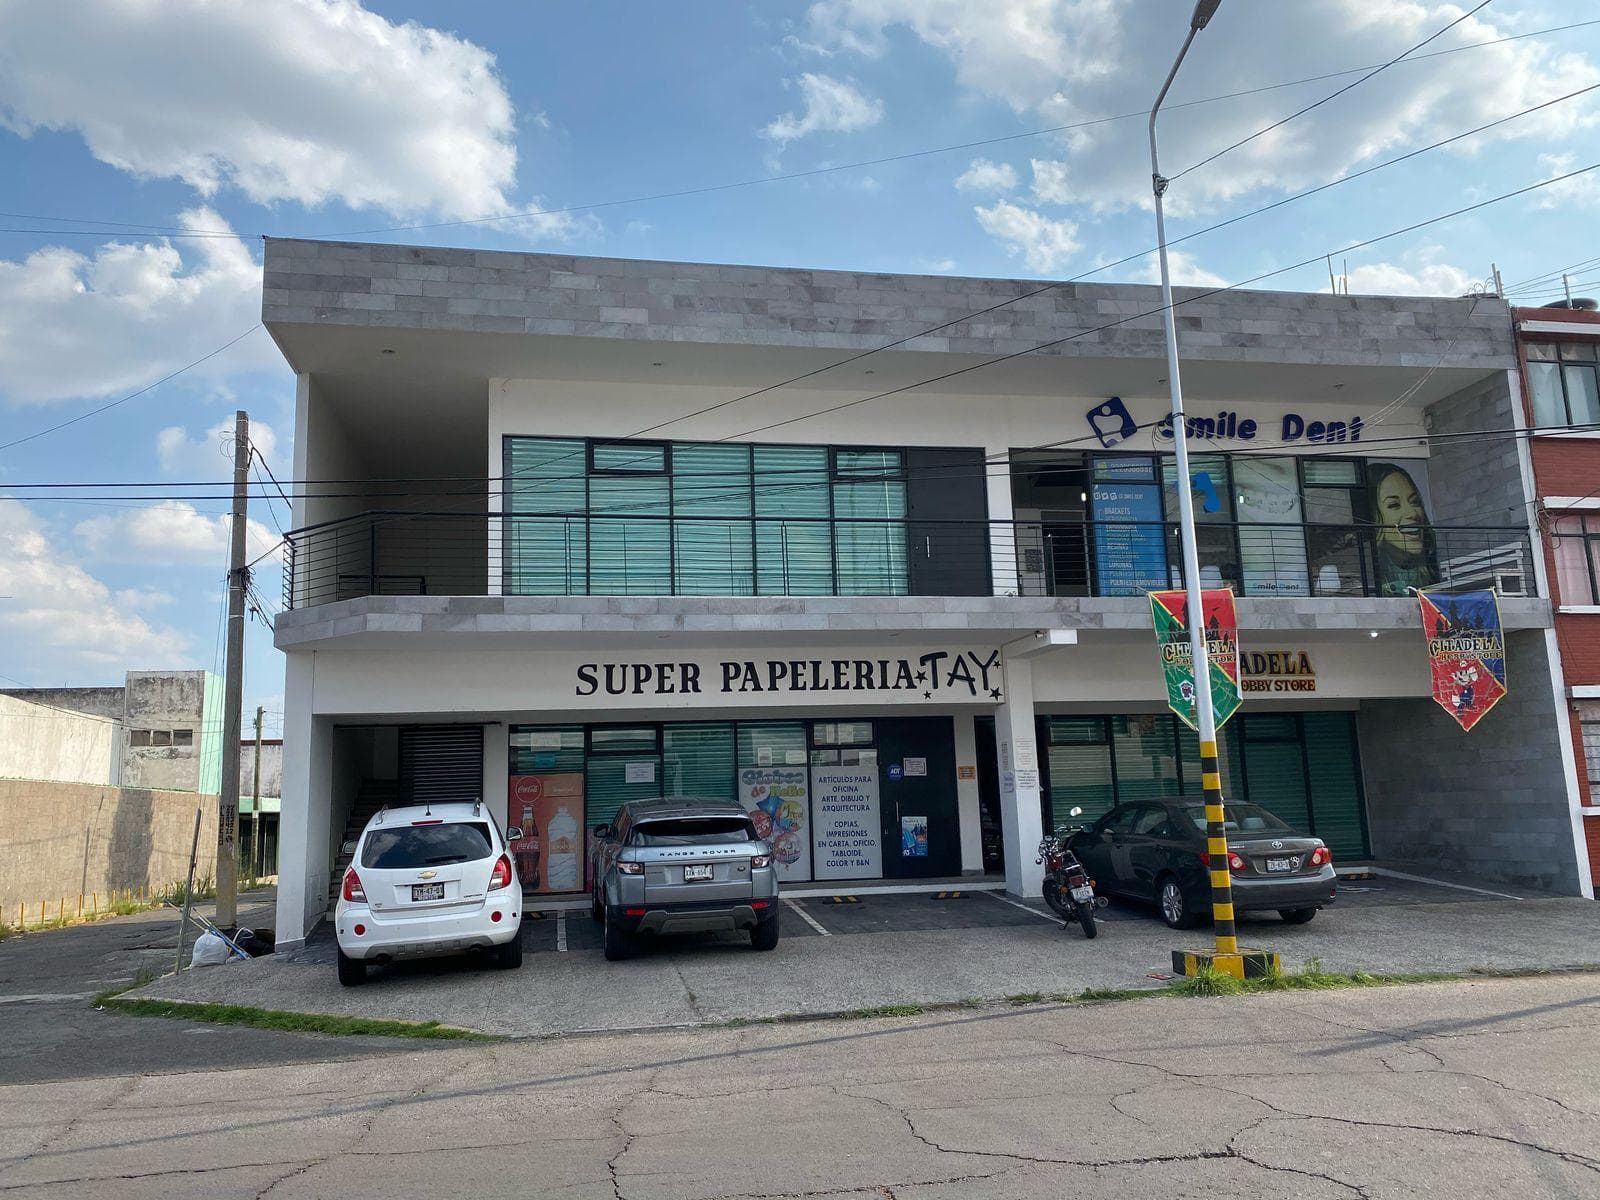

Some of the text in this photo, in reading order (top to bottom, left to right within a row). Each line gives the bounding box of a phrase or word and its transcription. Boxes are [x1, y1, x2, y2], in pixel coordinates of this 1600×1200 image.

[1282, 413, 1364, 442] Dent
[1163, 640, 1236, 662] CITELA
[1429, 638, 1503, 657] CITADELA
[1208, 655, 1237, 663] STOR
[1239, 653, 1314, 675] ADELA
[576, 650, 999, 696] SUPER PAPELERIA TAY
[1240, 680, 1316, 692] OBBY STORE
